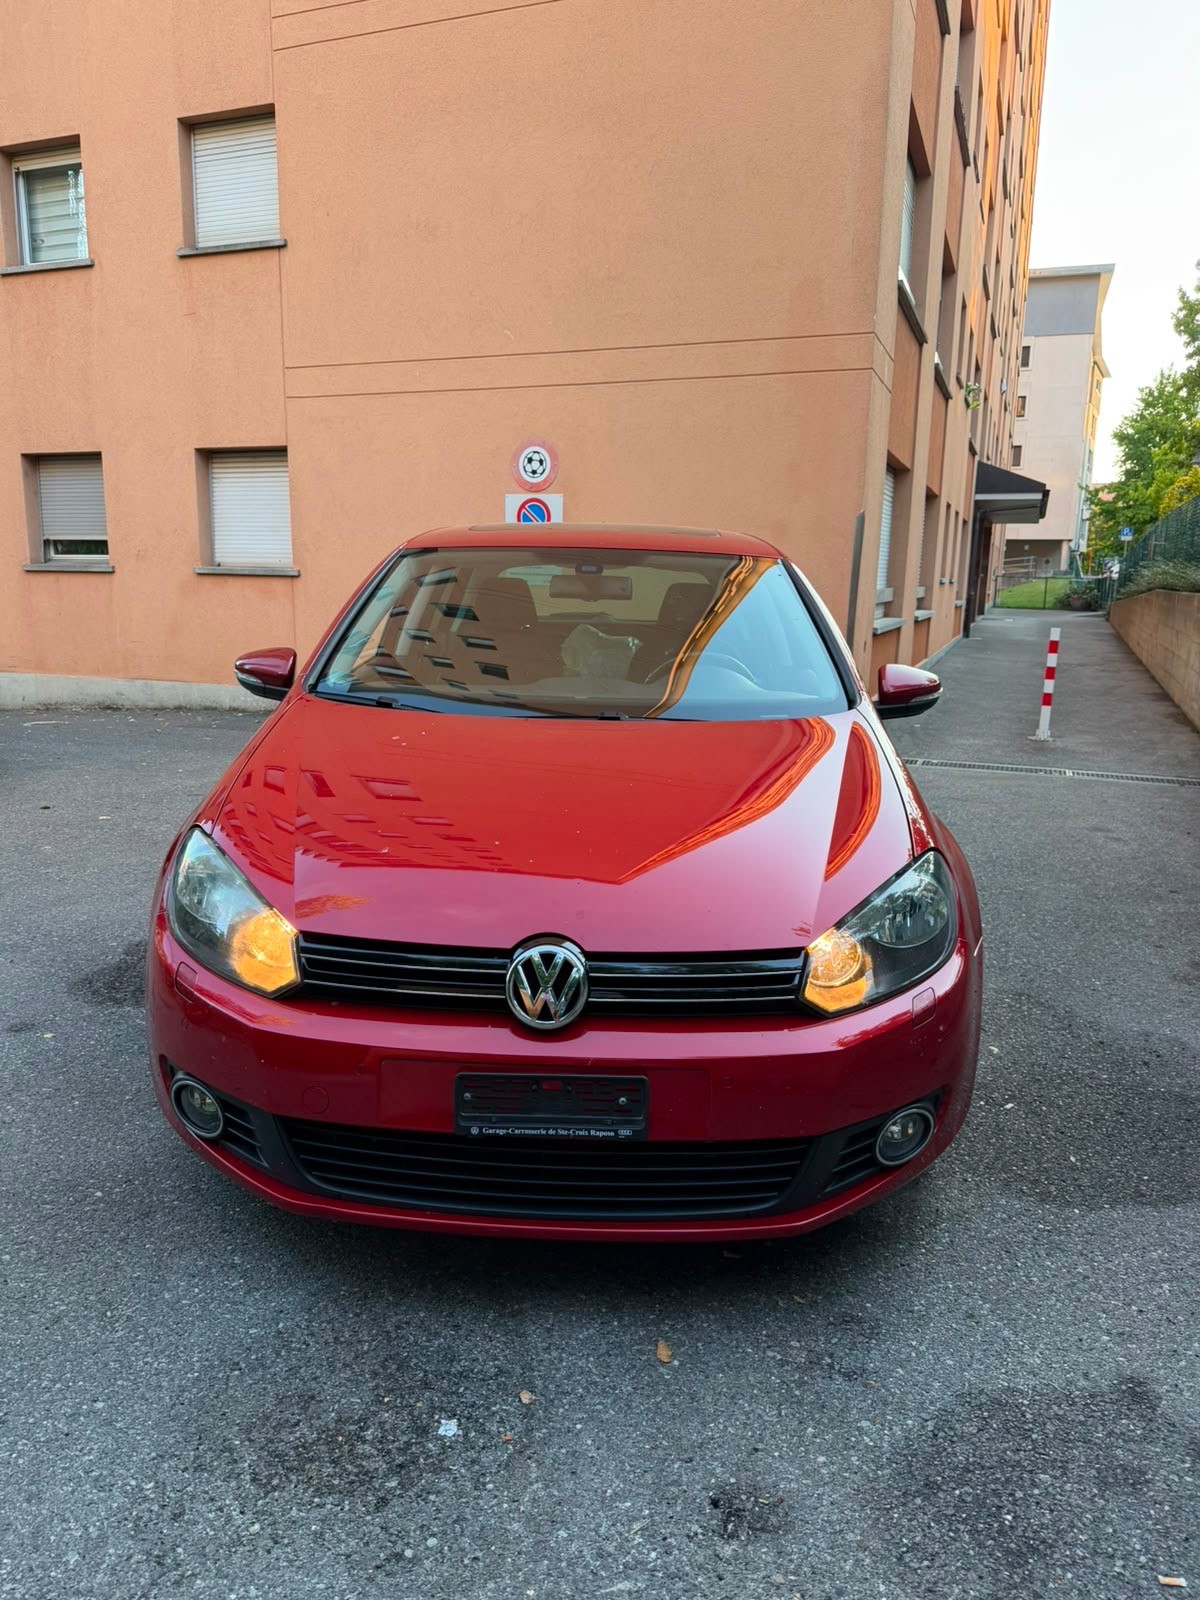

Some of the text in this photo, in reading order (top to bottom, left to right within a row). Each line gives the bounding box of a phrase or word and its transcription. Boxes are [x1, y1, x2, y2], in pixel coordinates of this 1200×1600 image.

[510, 948, 585, 1024] VW
[482, 1127, 547, 1135] Garage-Carrosserie
[590, 1129, 615, 1138] Raposo
